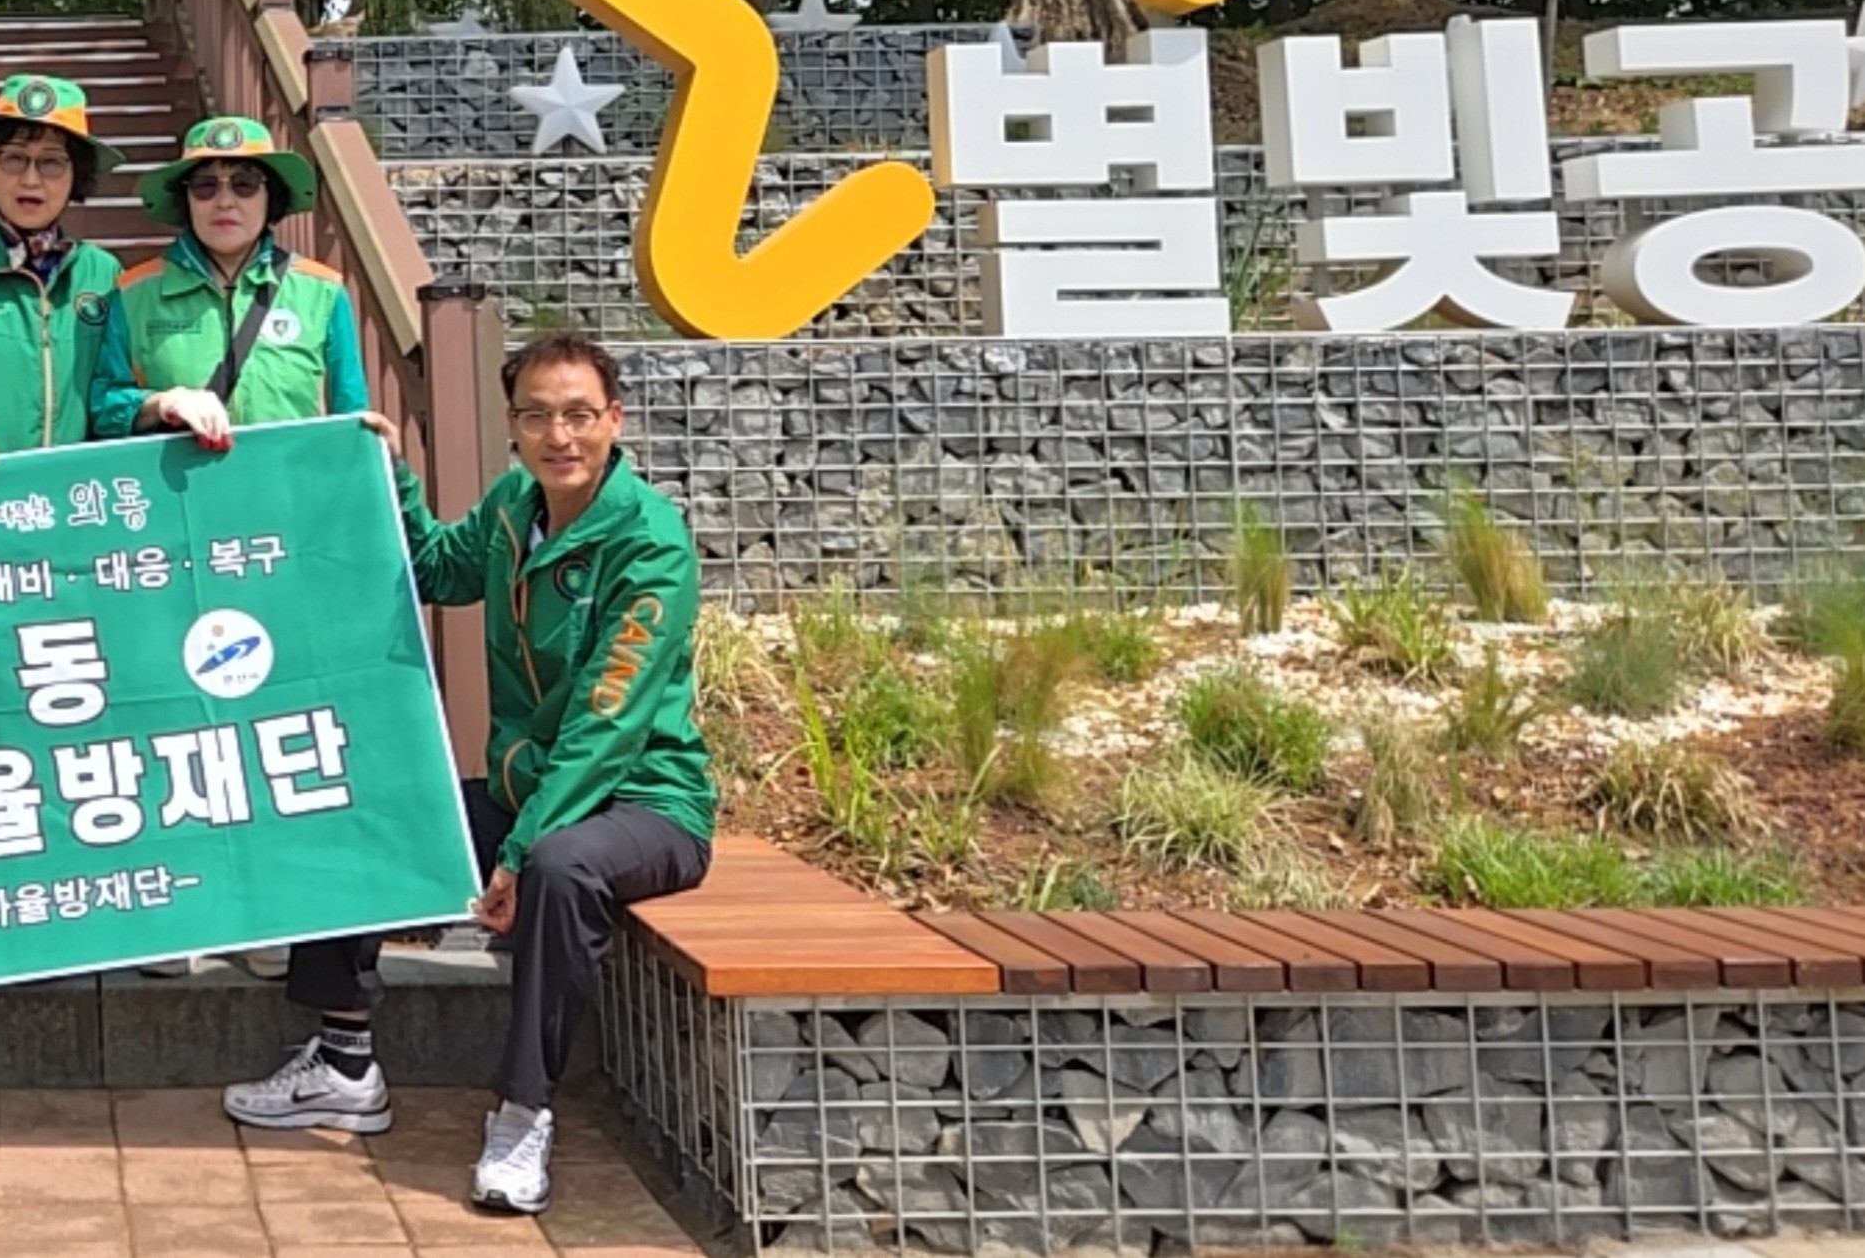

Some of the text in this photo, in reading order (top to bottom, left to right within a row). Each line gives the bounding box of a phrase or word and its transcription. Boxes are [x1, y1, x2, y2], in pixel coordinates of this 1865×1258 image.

[68, 478, 149, 530] 와동
[94, 547, 171, 591] 대응
[209, 535, 286, 578] 복구
